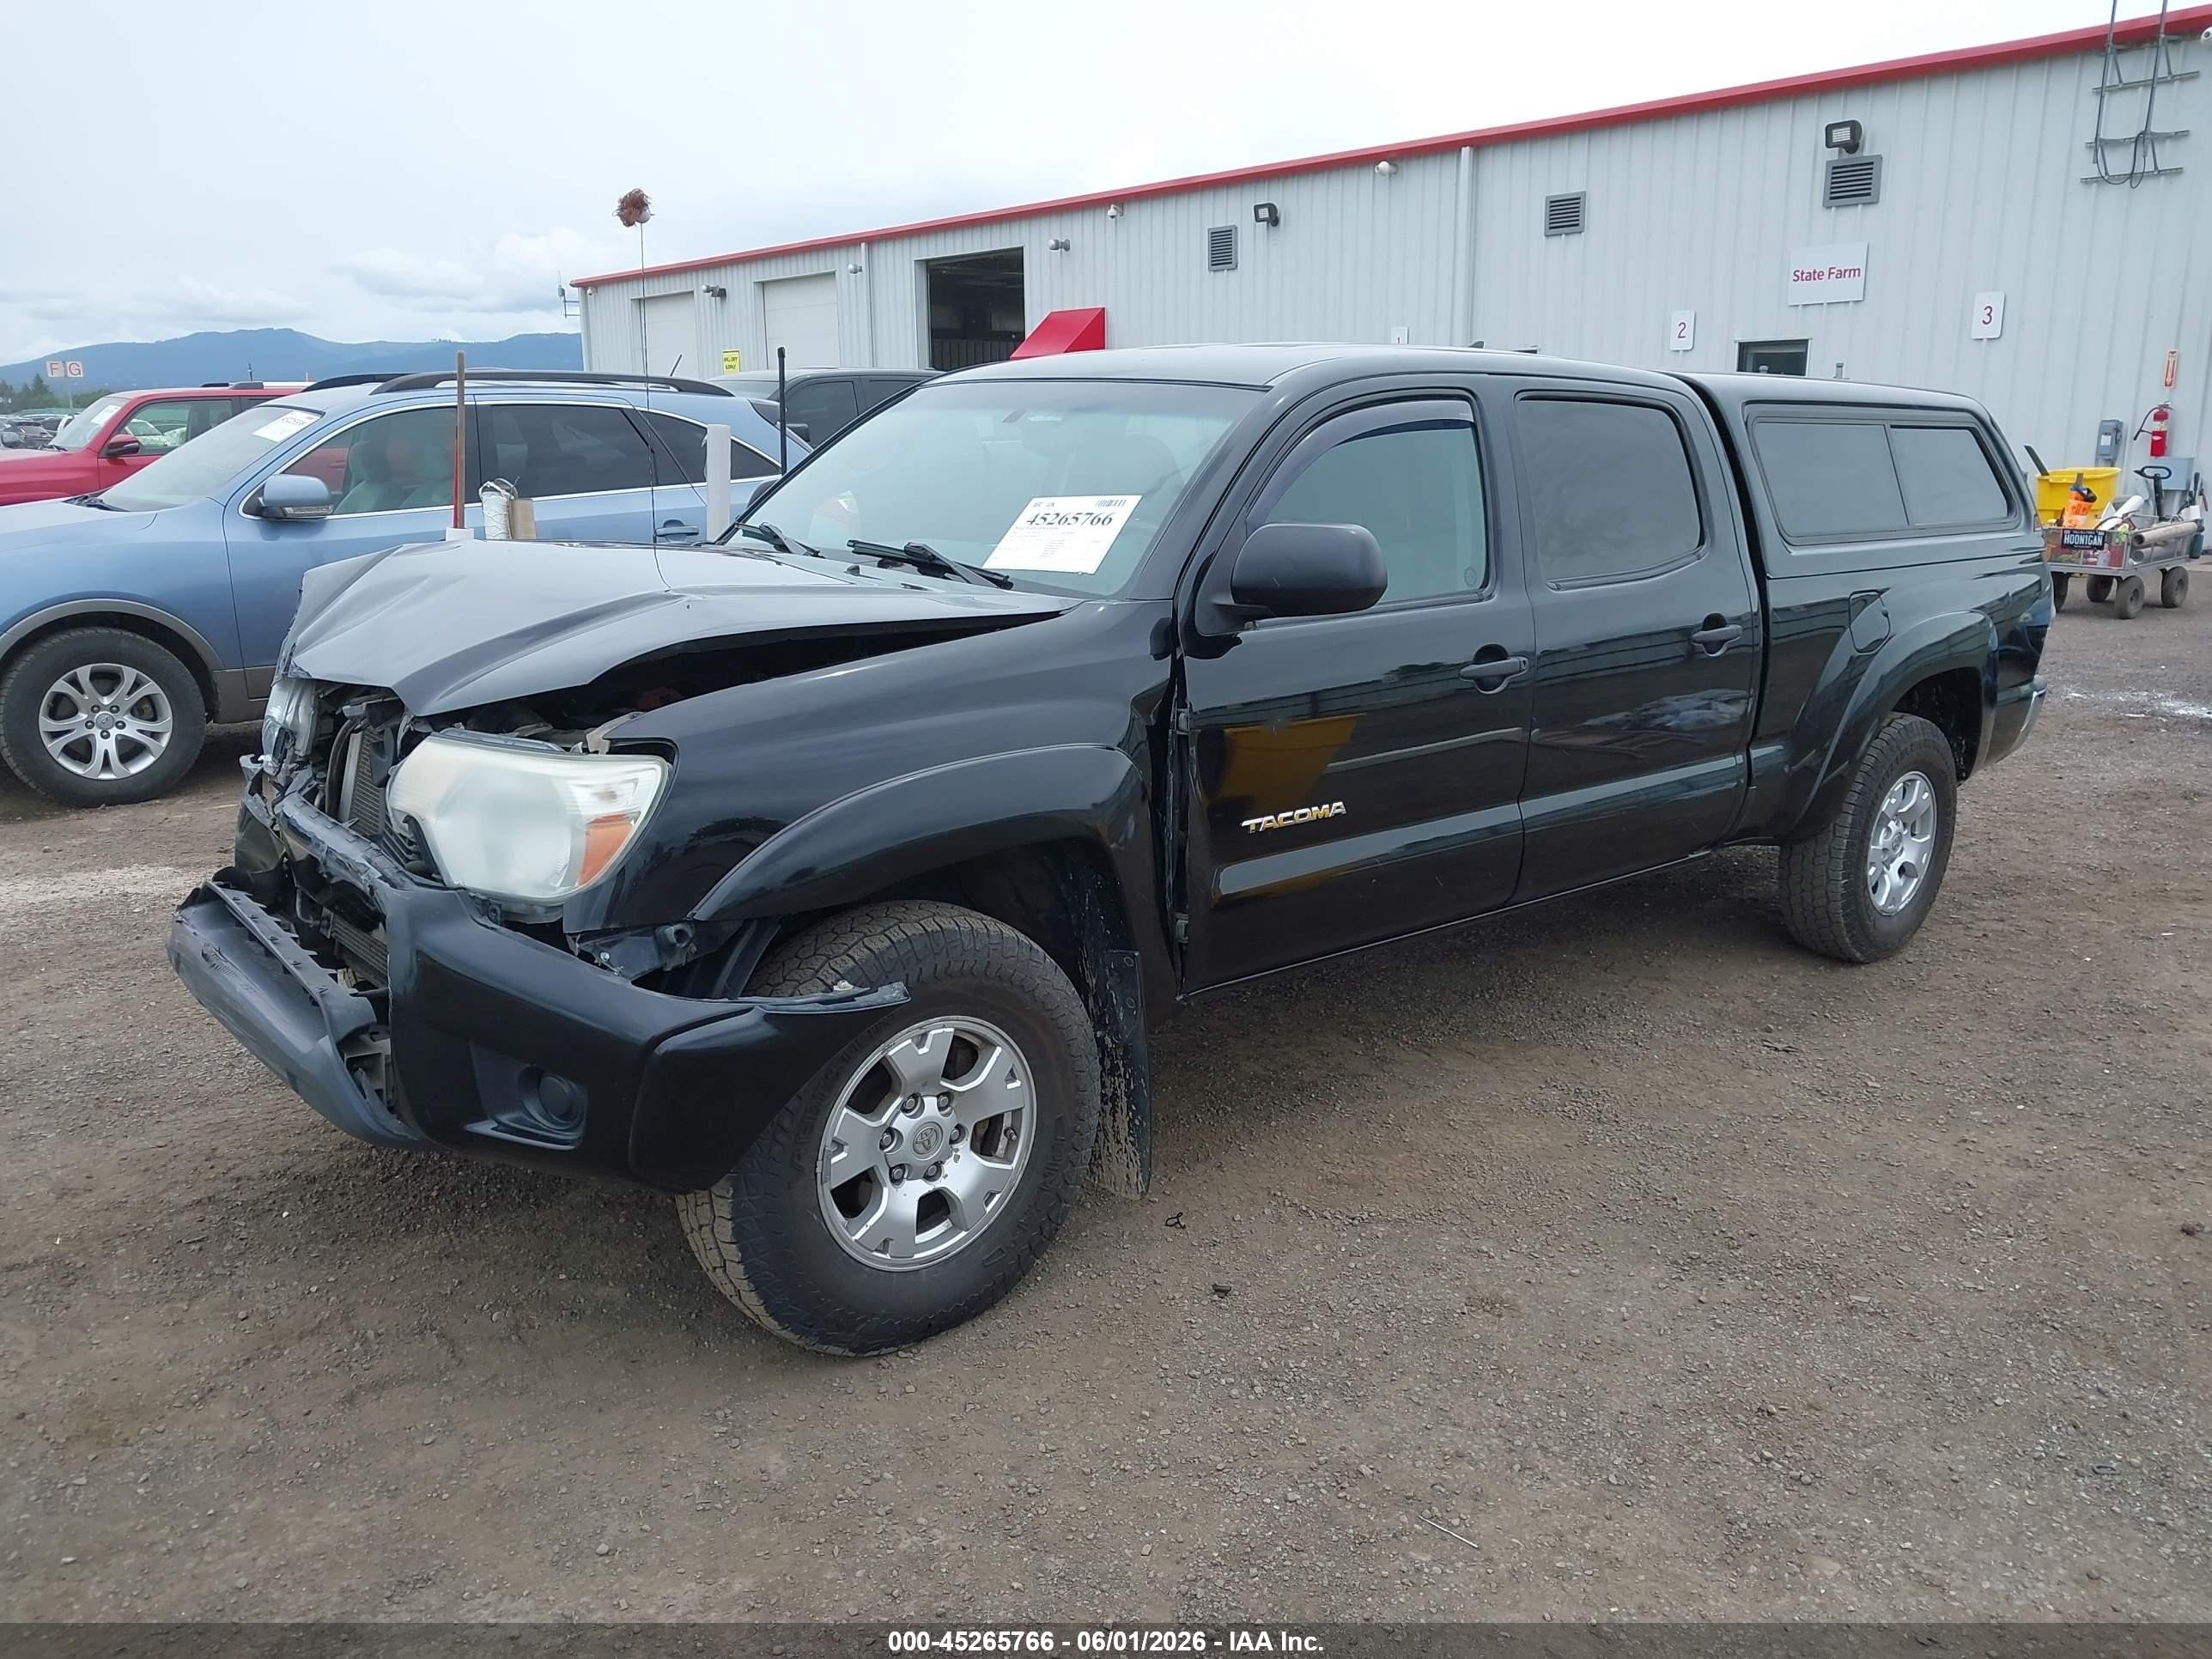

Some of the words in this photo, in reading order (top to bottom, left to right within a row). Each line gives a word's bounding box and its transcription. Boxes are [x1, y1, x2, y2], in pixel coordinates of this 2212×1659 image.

[1792, 268, 1825, 283] State
[1827, 266, 1862, 280] Farm
[1982, 305, 1993, 325] 3
[1677, 321, 1686, 339] 2
[50, 362, 59, 376] F
[69, 362, 82, 376] G
[1026, 512, 1115, 526] 45265766
[1242, 801, 1347, 834] TACOMA
